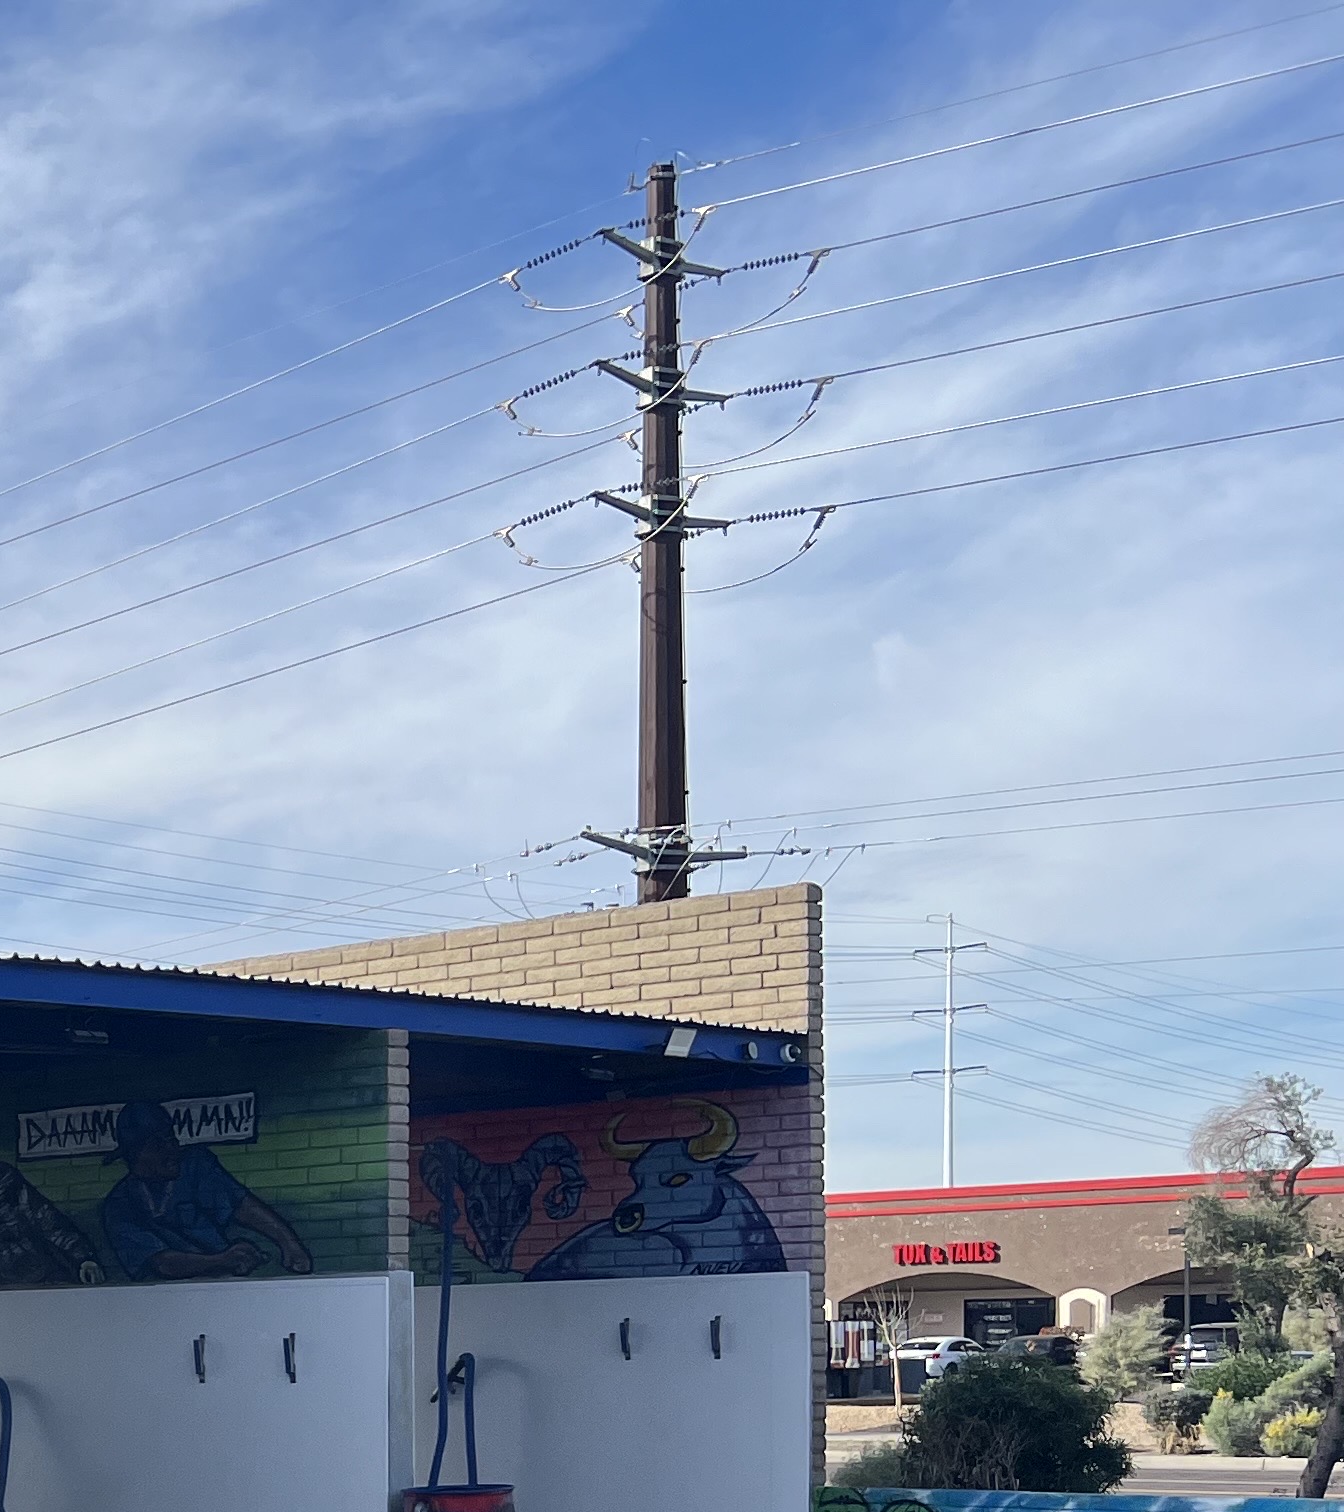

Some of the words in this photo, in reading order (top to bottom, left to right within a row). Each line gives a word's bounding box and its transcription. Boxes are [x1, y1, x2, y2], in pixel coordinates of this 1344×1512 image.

[892, 1243, 928, 1265] TUX
[930, 1246, 944, 1265] &
[946, 1241, 996, 1265] TAILS
